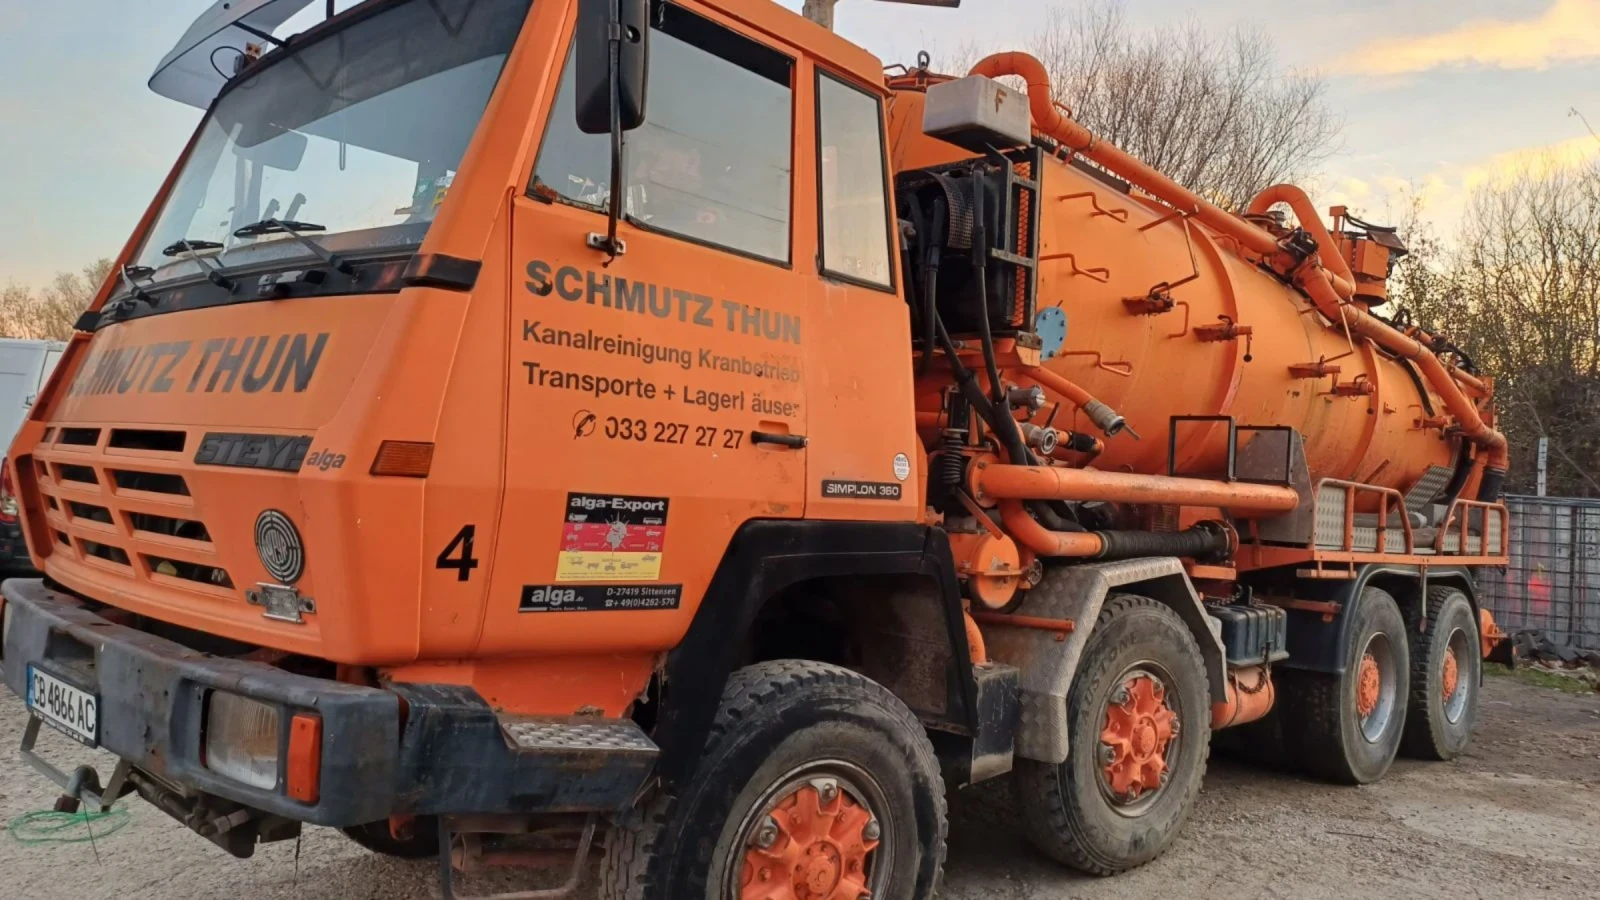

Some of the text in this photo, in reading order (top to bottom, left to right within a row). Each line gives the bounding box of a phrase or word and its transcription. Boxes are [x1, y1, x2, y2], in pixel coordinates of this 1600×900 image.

[995, 88, 1007, 114] F
[525, 260, 801, 345] SCHMUTZ THUN
[70, 332, 330, 396] HMUTZ THUN
[523, 319, 800, 383] Kanalreinigung Kranbetrieb
[522, 361, 656, 398] Transporte
[664, 384, 676, 401] +
[604, 416, 744, 450] 033 227 27 27
[306, 447, 347, 471] alga
[570, 496, 665, 512] alga-Export
[826, 483, 899, 496] SIMPLON 360
[436, 524, 479, 582] 4
[606, 587, 677, 596] D-27419 Sittensen
[34, 673, 46, 709] CB
[48, 681, 75, 724] 4866
[77, 695, 95, 733] AC
